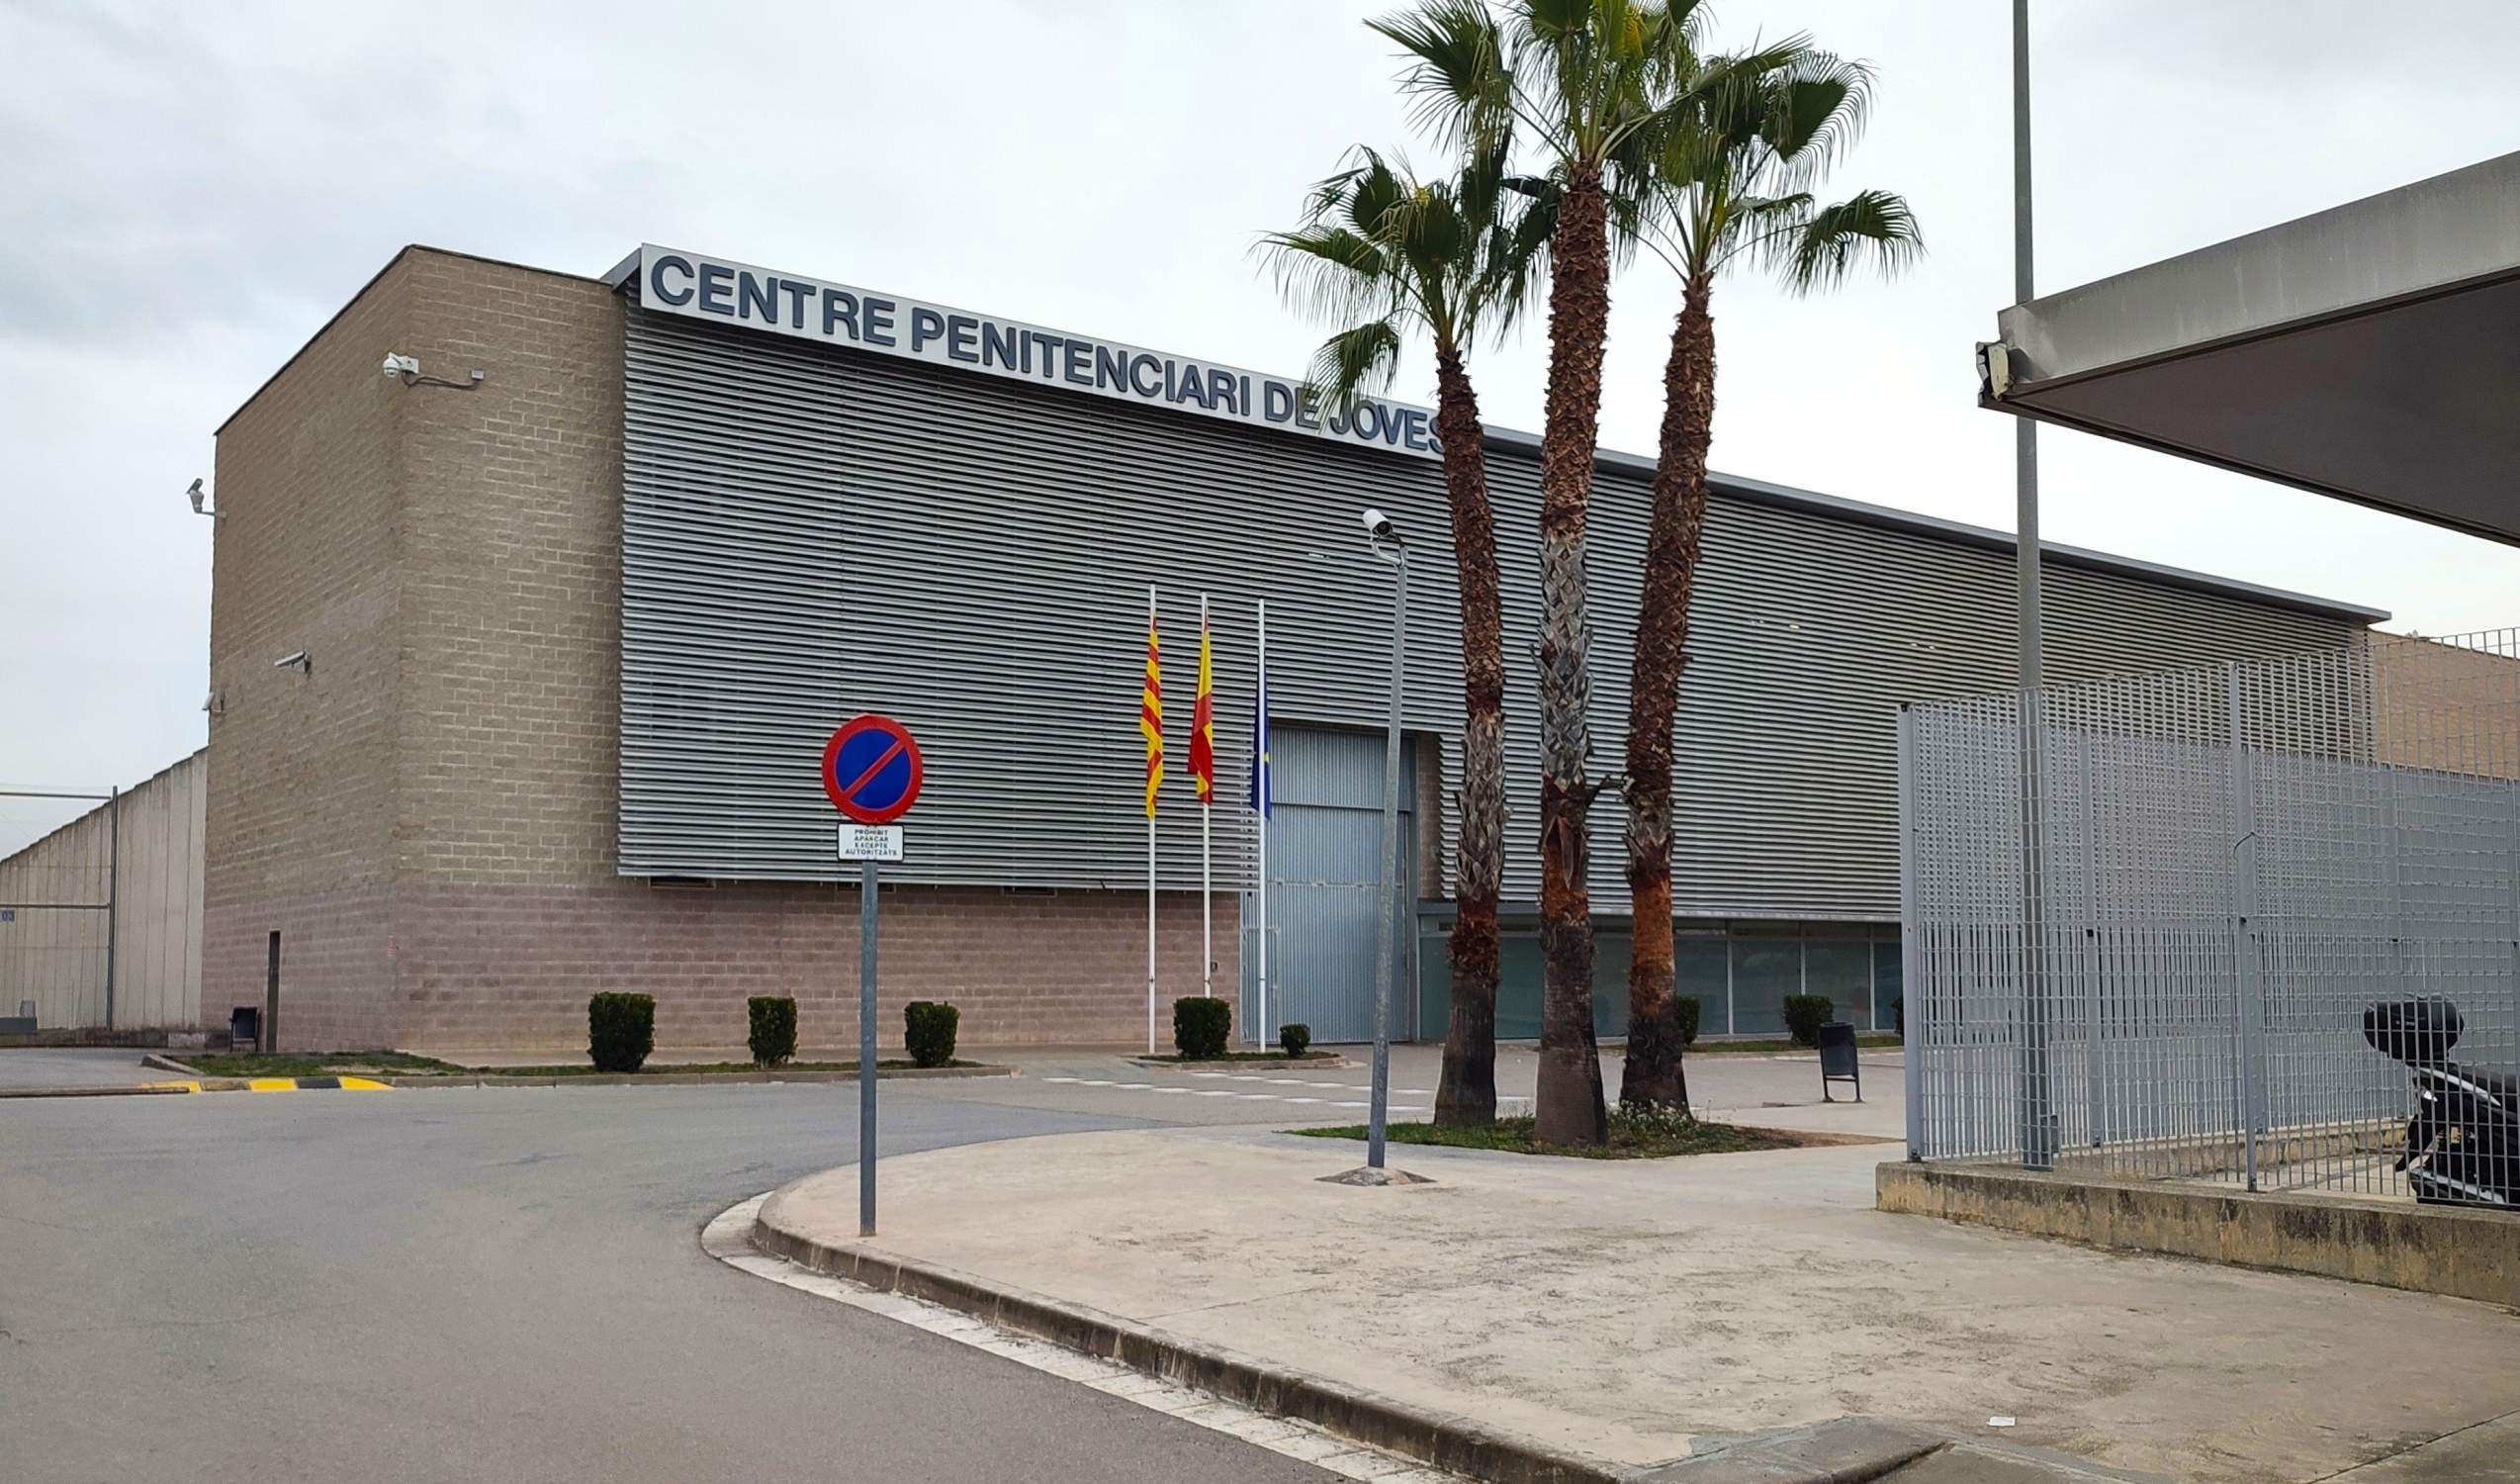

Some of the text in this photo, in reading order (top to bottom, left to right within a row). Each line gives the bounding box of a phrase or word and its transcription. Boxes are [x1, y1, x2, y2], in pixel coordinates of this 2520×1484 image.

[651, 255, 896, 347] CENTRE
[912, 307, 1250, 417] PENITENCIARI
[1264, 380, 1320, 428] DE
